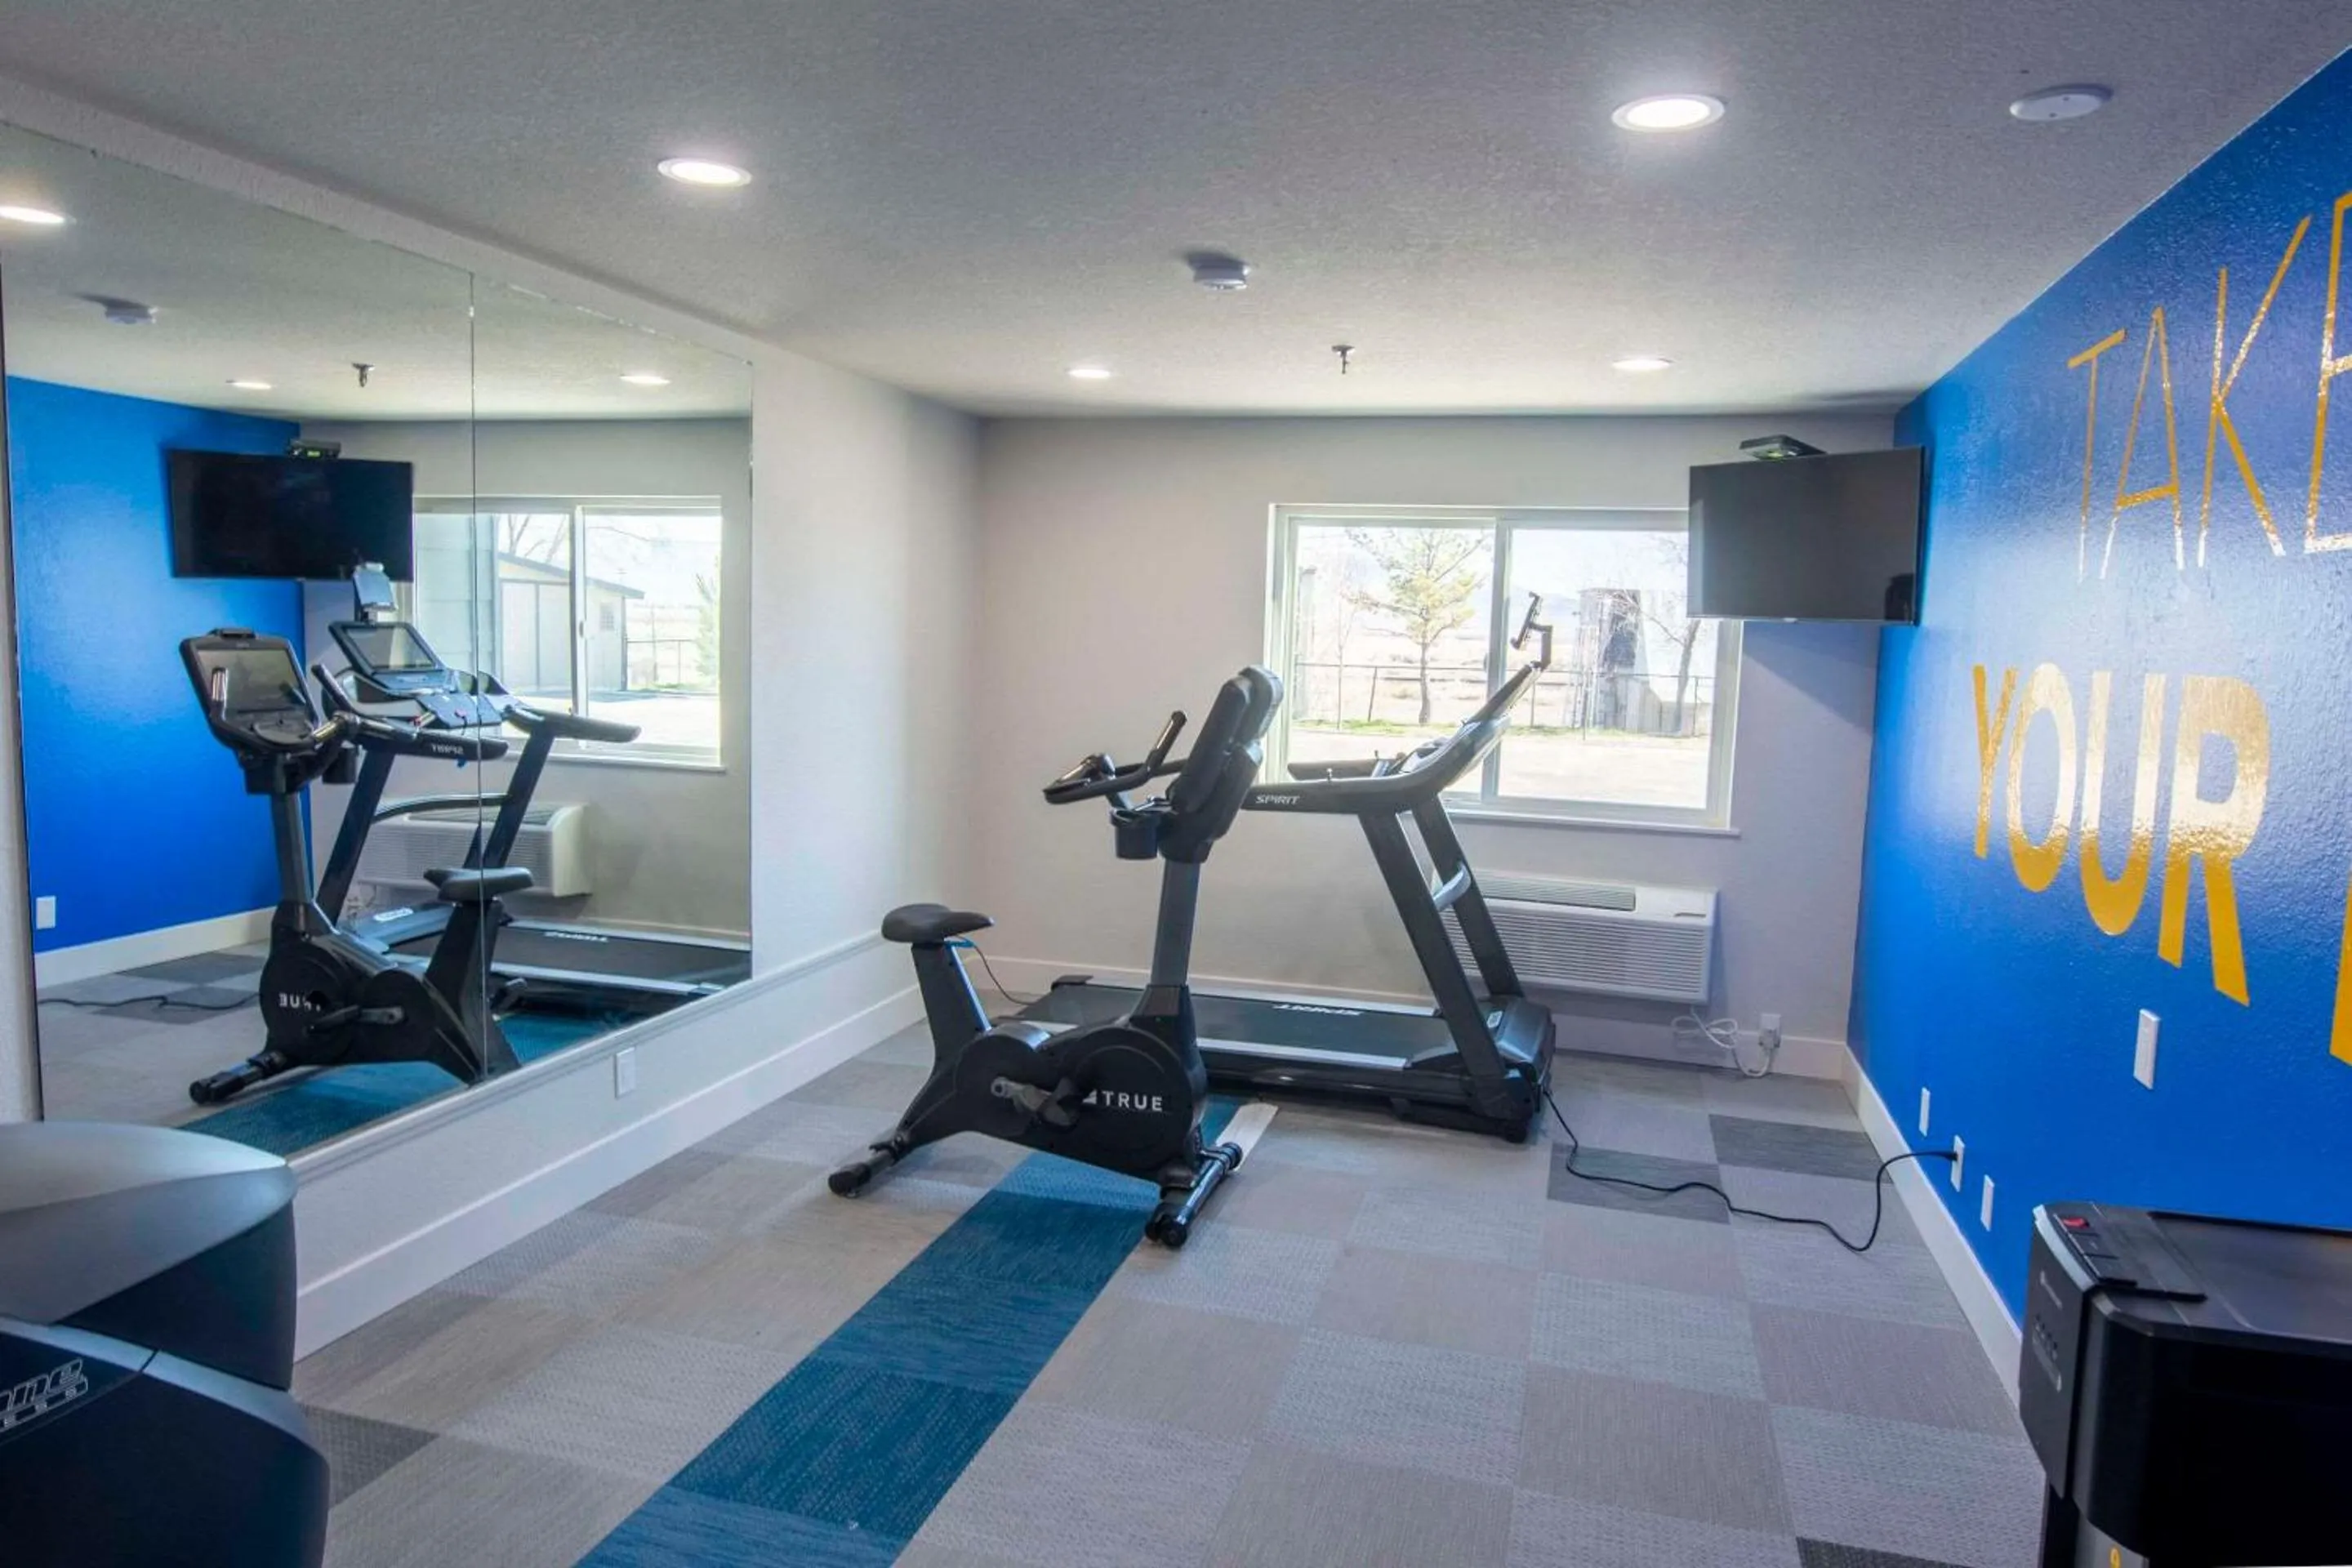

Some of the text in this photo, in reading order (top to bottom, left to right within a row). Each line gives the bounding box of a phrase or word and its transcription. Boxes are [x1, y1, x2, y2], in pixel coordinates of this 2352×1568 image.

[1255, 795, 1300, 804] SPIRIT
[1972, 662, 2270, 1008] YOUR
[1102, 1090, 1162, 1111] TRUE
